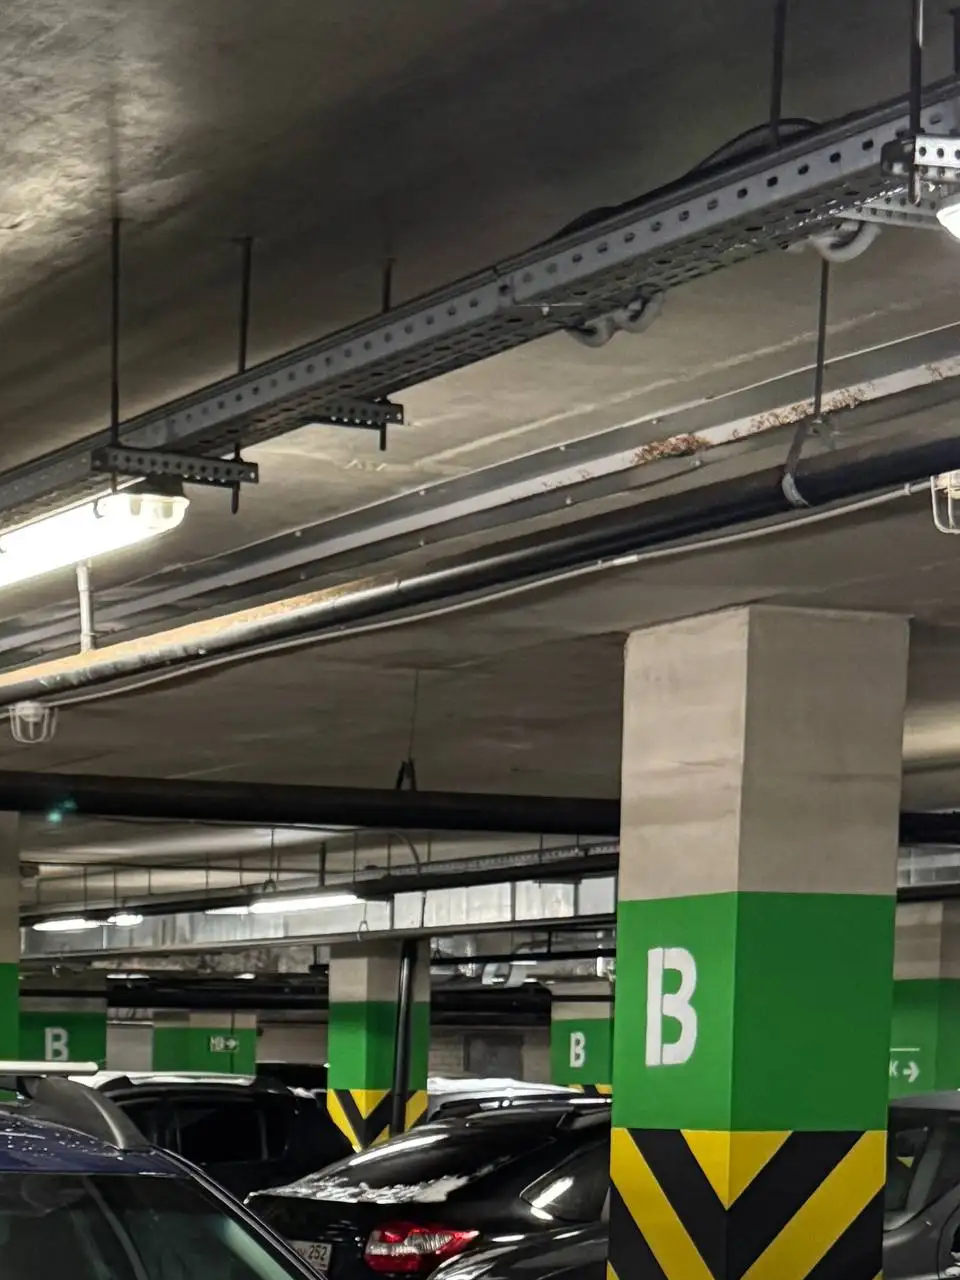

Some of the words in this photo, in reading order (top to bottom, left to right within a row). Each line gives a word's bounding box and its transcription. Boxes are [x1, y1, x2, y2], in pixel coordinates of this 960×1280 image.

[645, 947, 697, 1067] B
[45, 1027, 69, 1061] B
[569, 1032, 586, 1068] B
